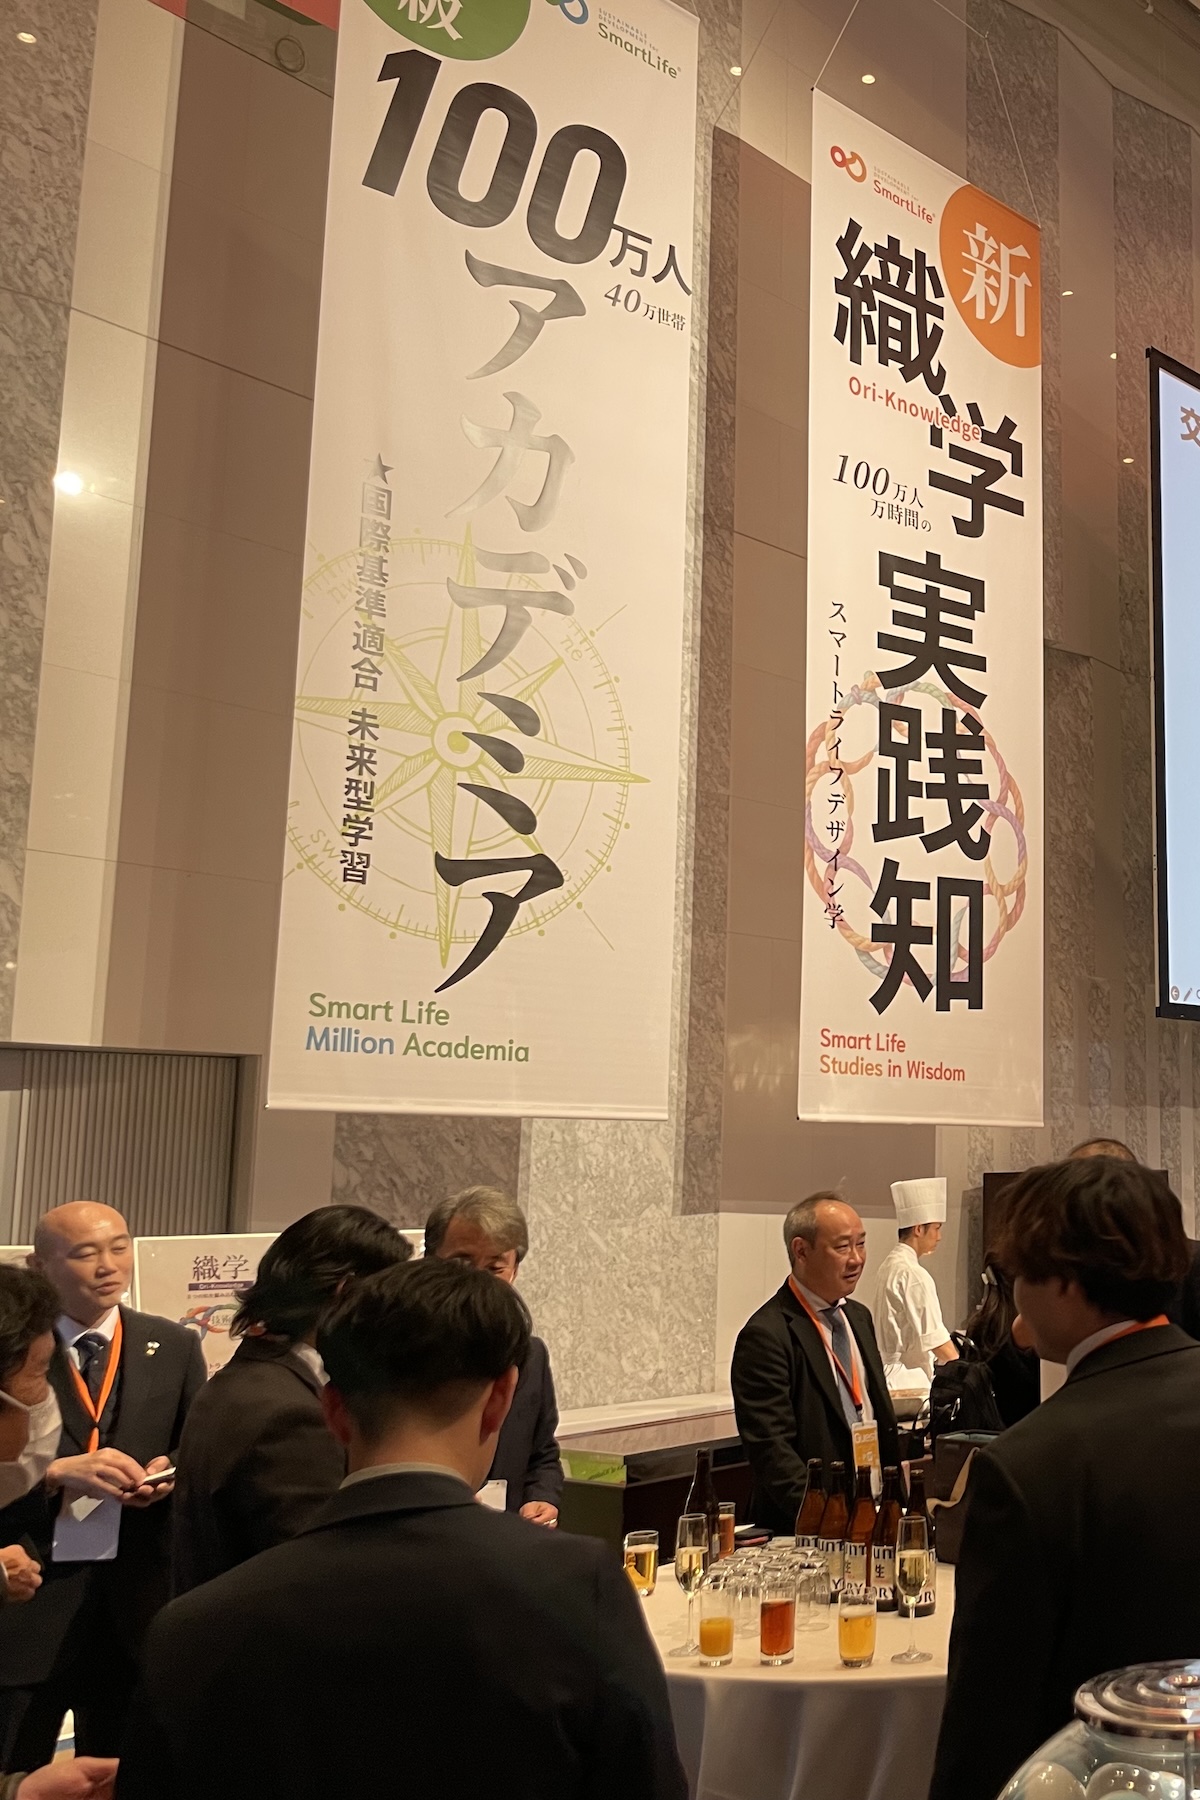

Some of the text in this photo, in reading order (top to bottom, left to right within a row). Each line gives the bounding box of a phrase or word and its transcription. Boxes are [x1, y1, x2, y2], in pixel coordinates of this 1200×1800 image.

[598, 7, 648, 39] SUSTAINABLE
[598, 22, 678, 79] SmartLife
[873, 179, 933, 224] SmartLife
[961, 222, 1032, 338] 新
[603, 283, 687, 332] 40万世帯
[848, 376, 982, 442] Ori-Knowledge
[832, 454, 925, 509] 100万人
[870, 499, 932, 533] 万時間の
[434, 249, 588, 993] アカデミア
[340, 481, 394, 885] 国際基準適合 未来型学習
[823, 600, 848, 930] スマートライフデザイン学
[308, 992, 450, 1026] Smart Life
[305, 1025, 530, 1062] Million Academia
[820, 1028, 906, 1053] Smart Life
[820, 1054, 966, 1082] Studies in Wisdom
[192, 1255, 250, 1281] 織学
